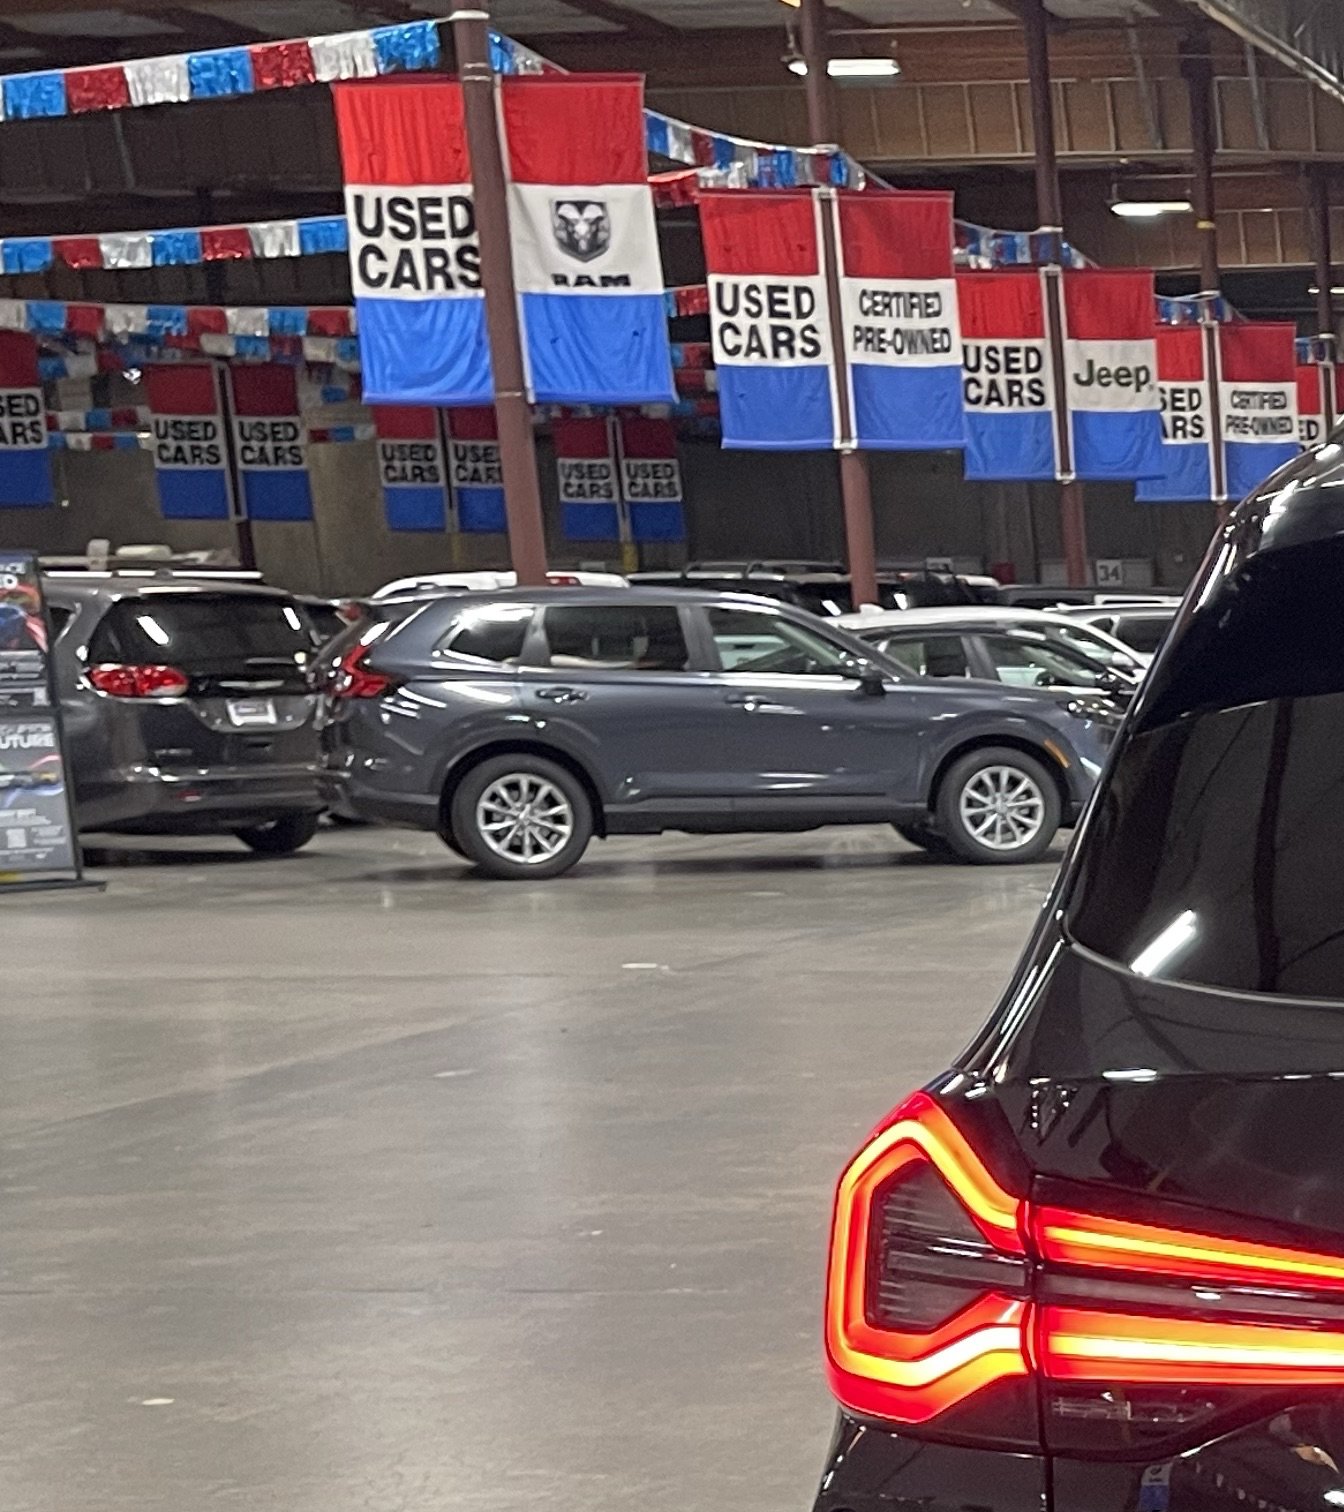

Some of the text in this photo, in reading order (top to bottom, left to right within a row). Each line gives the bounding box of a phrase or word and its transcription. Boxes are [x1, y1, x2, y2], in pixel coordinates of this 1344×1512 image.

[354, 195, 475, 241] USED
[358, 244, 482, 291] CARS
[551, 273, 631, 287] RAM
[715, 282, 816, 319] USED
[859, 289, 943, 318] CERTIFIED
[719, 322, 822, 358] CARS
[853, 325, 951, 355] PRE-OWNED
[962, 345, 1043, 374] USED
[1073, 359, 1151, 393] Jeep
[964, 377, 1046, 407] CARS
[1159, 387, 1202, 412] SED
[155, 419, 217, 441] USED
[239, 421, 299, 442] USED
[157, 443, 221, 465] CARS
[241, 445, 303, 466] CARS
[382, 443, 437, 461] USED
[454, 444, 500, 463] USE
[384, 464, 440, 482] CARS
[455, 464, 503, 483] CAR
[561, 463, 611, 480] USED
[626, 463, 675, 480] USED
[563, 482, 613, 498] CARS
[628, 481, 679, 498] CARS
